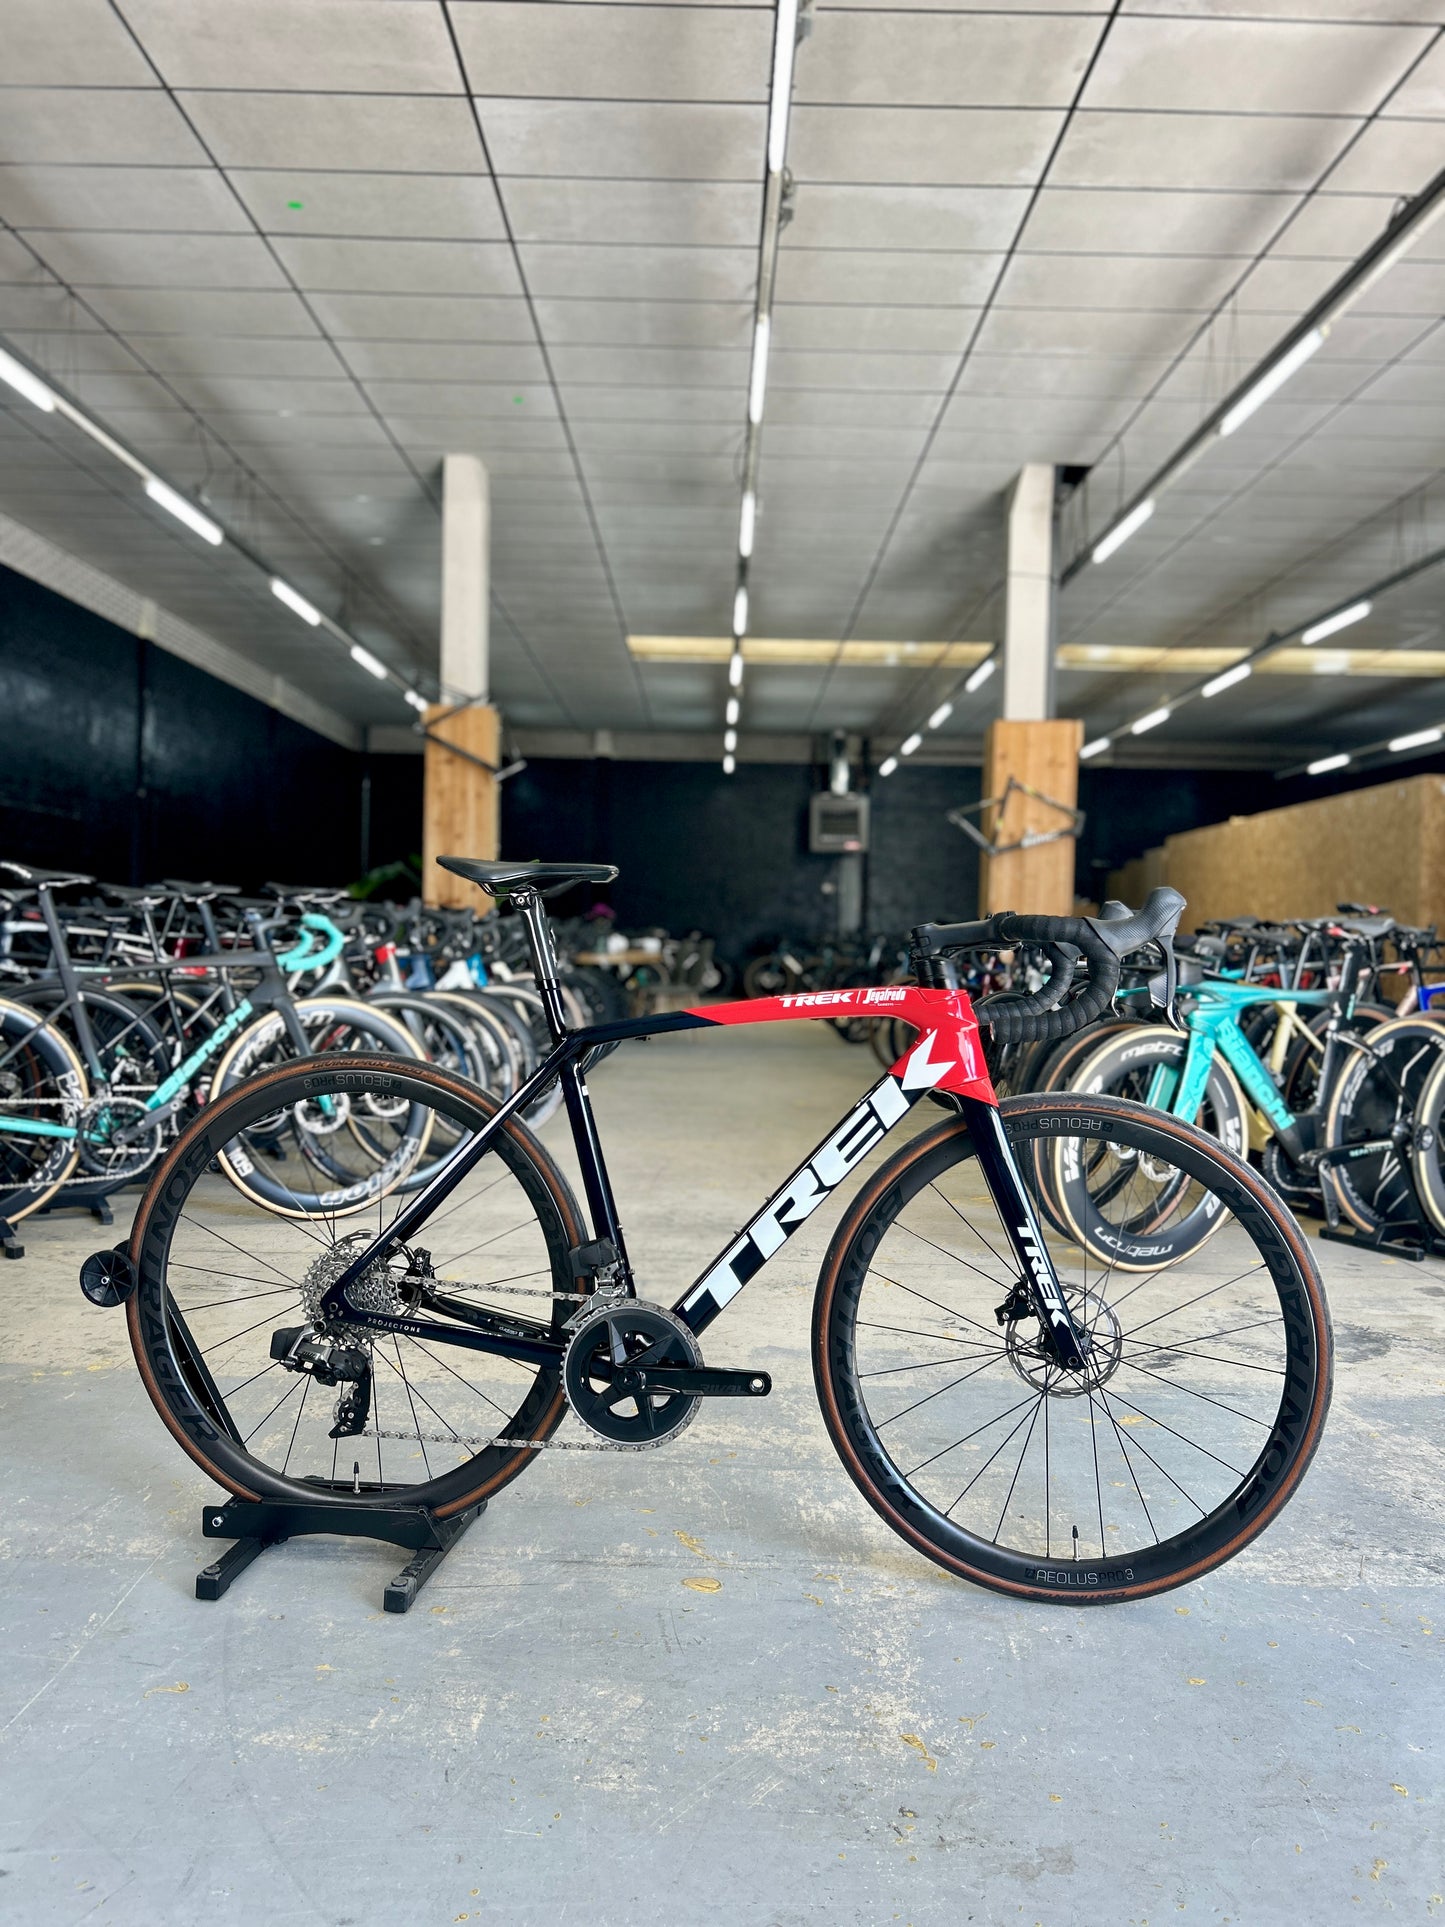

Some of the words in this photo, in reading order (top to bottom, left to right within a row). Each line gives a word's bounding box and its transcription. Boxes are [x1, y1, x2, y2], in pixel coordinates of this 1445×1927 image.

[779, 992, 854, 1008] TREK
[1217, 1017, 1296, 1130] Bianchi
[683, 1028, 957, 1311] TREK
[1094, 1227, 1174, 1257] metron
[142, 1134, 220, 1443] BONTRAGER
[830, 1183, 921, 1512] BONTRAGER
[1014, 1217, 1069, 1328] TREK
[1226, 1185, 1316, 1525] BONTRAGER
